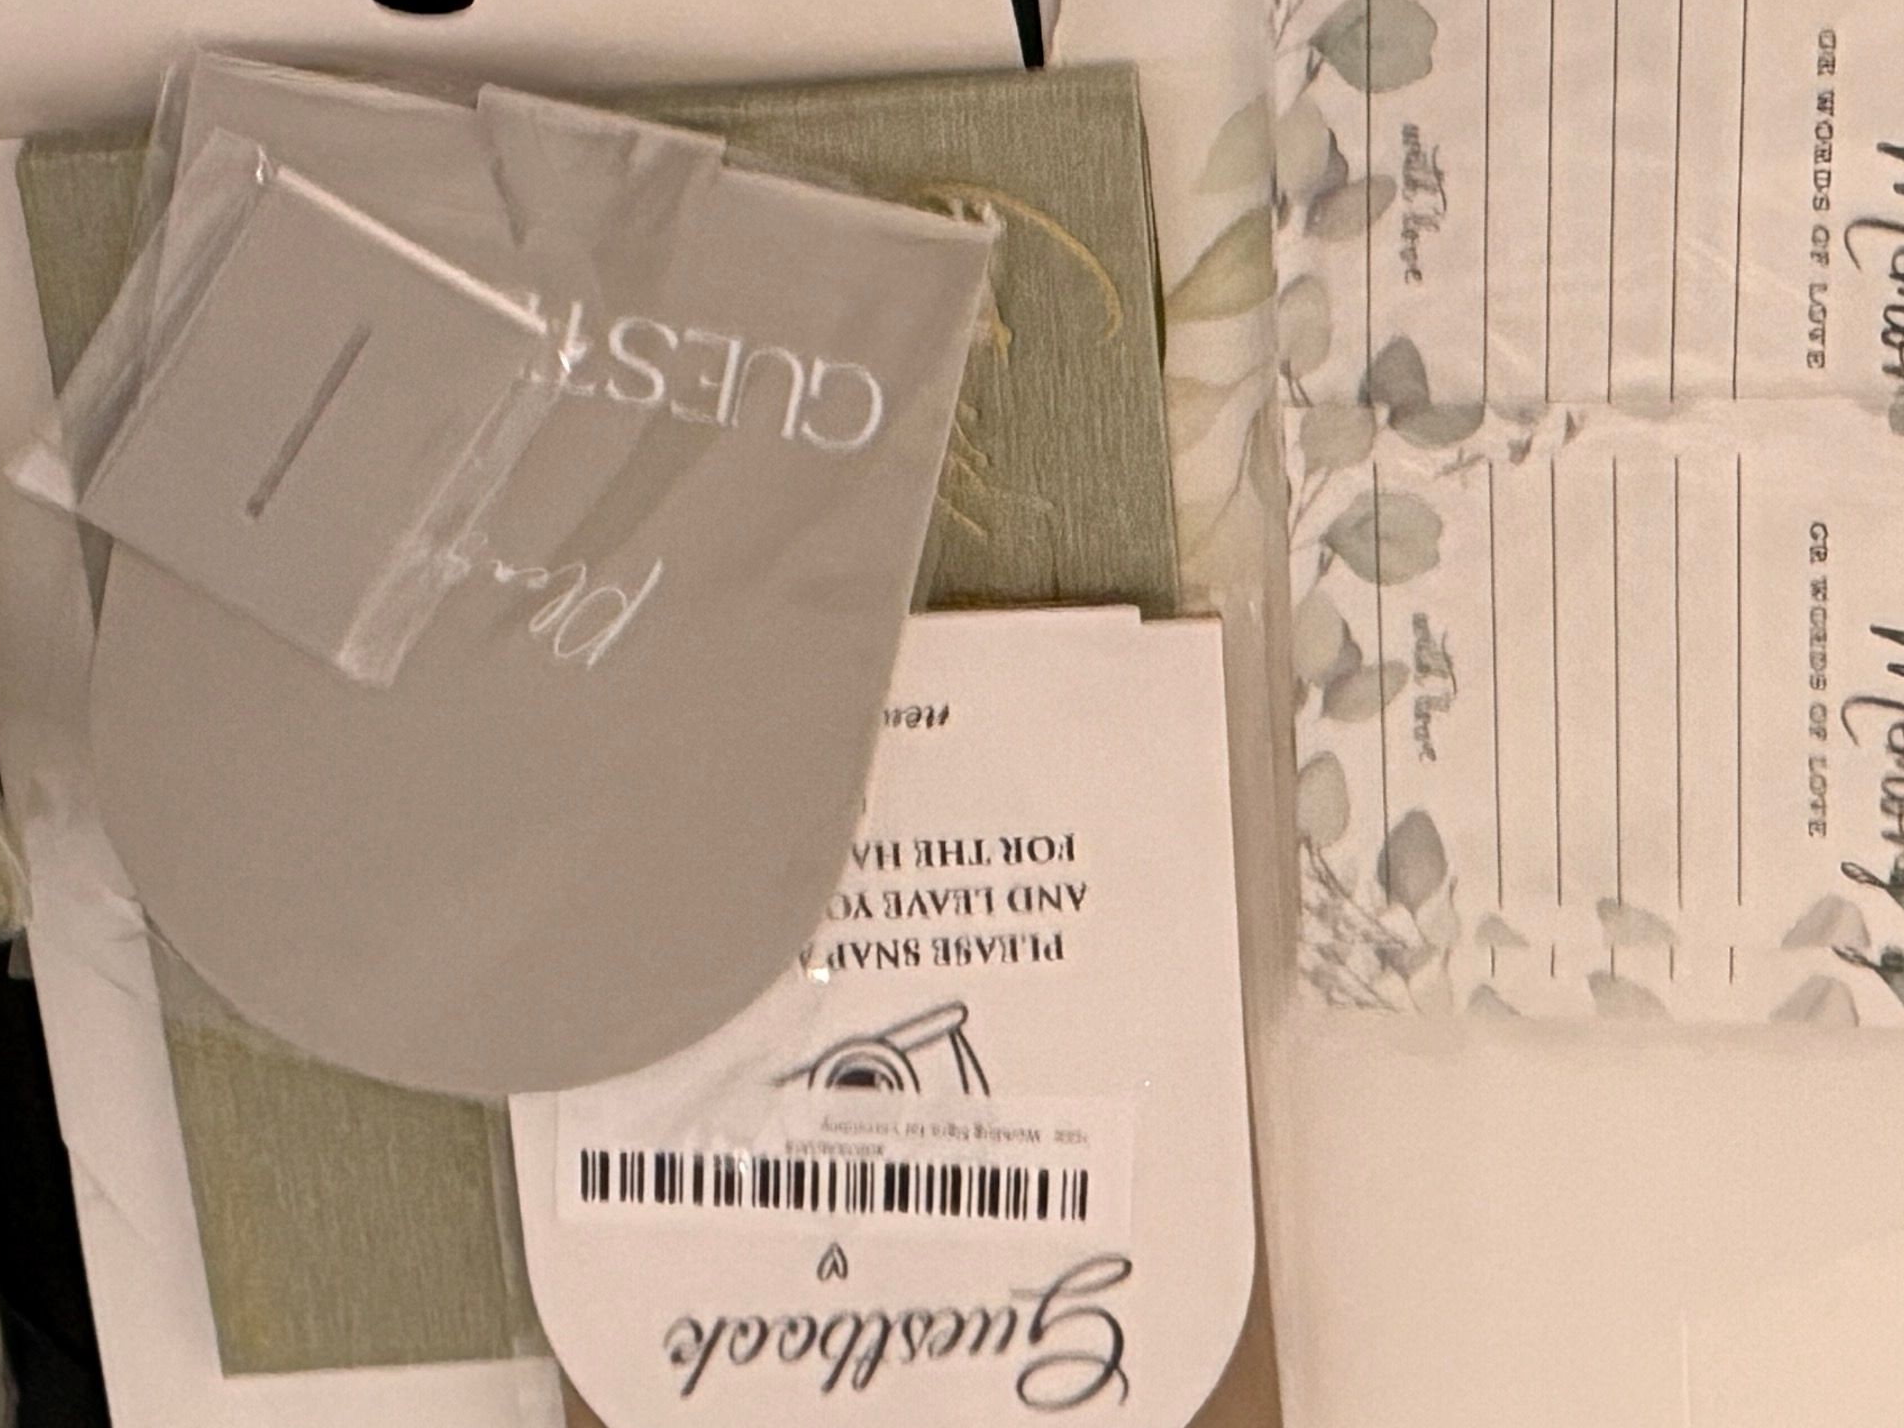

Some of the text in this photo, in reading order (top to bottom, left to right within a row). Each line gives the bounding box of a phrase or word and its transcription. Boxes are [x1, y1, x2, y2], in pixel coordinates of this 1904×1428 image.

[1806, 28, 1837, 371] OR WORDS OF LOVE
[518, 291, 882, 451] GUEST
[1807, 521, 1830, 839] OR WORDS OF LOVE
[912, 838, 991, 869] THE
[998, 832, 1076, 866] FOR
[824, 882, 1088, 922] AND LEAVE YO
[824, 937, 922, 973] SNAP
[929, 931, 1065, 967] PLEASE
[662, 1255, 1133, 1413] Guestbook
